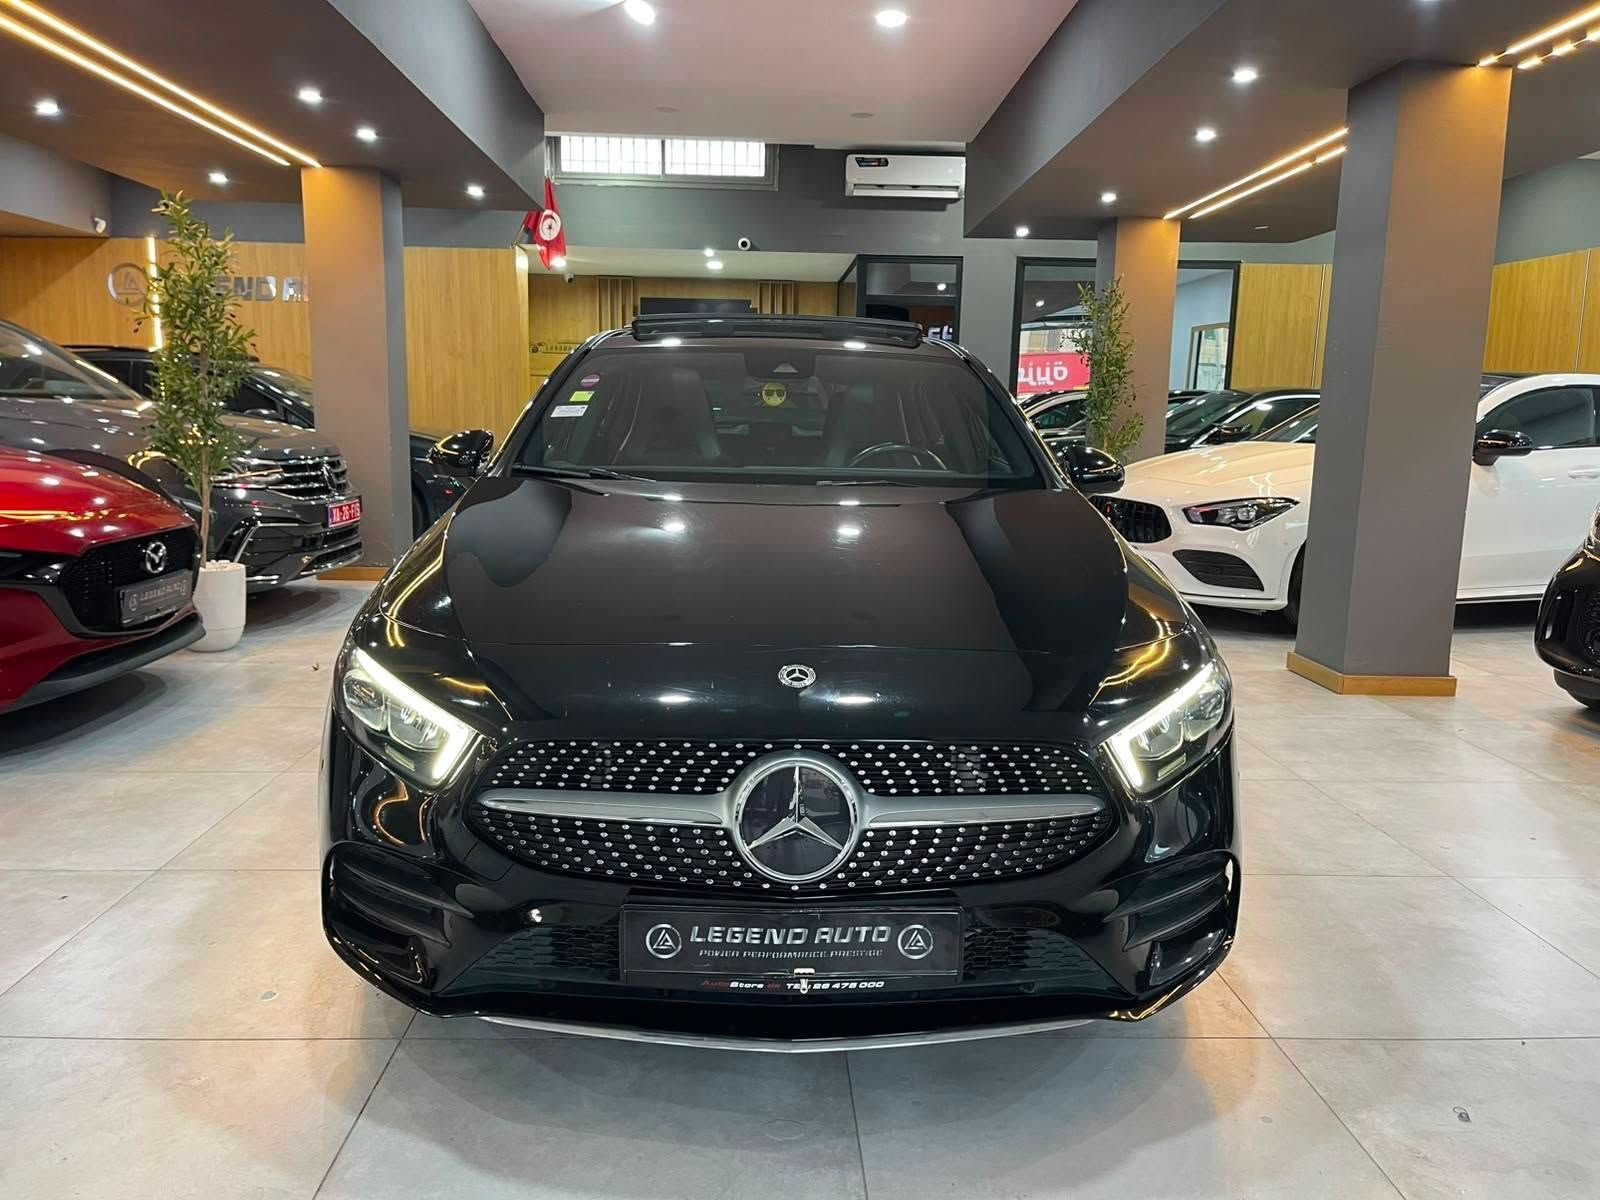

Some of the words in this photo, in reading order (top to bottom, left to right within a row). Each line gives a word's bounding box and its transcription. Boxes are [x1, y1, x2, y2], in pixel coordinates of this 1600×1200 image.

[690, 926, 808, 945] LEGEND
[814, 926, 891, 944] AUTO
[859, 981, 885, 989] 000
